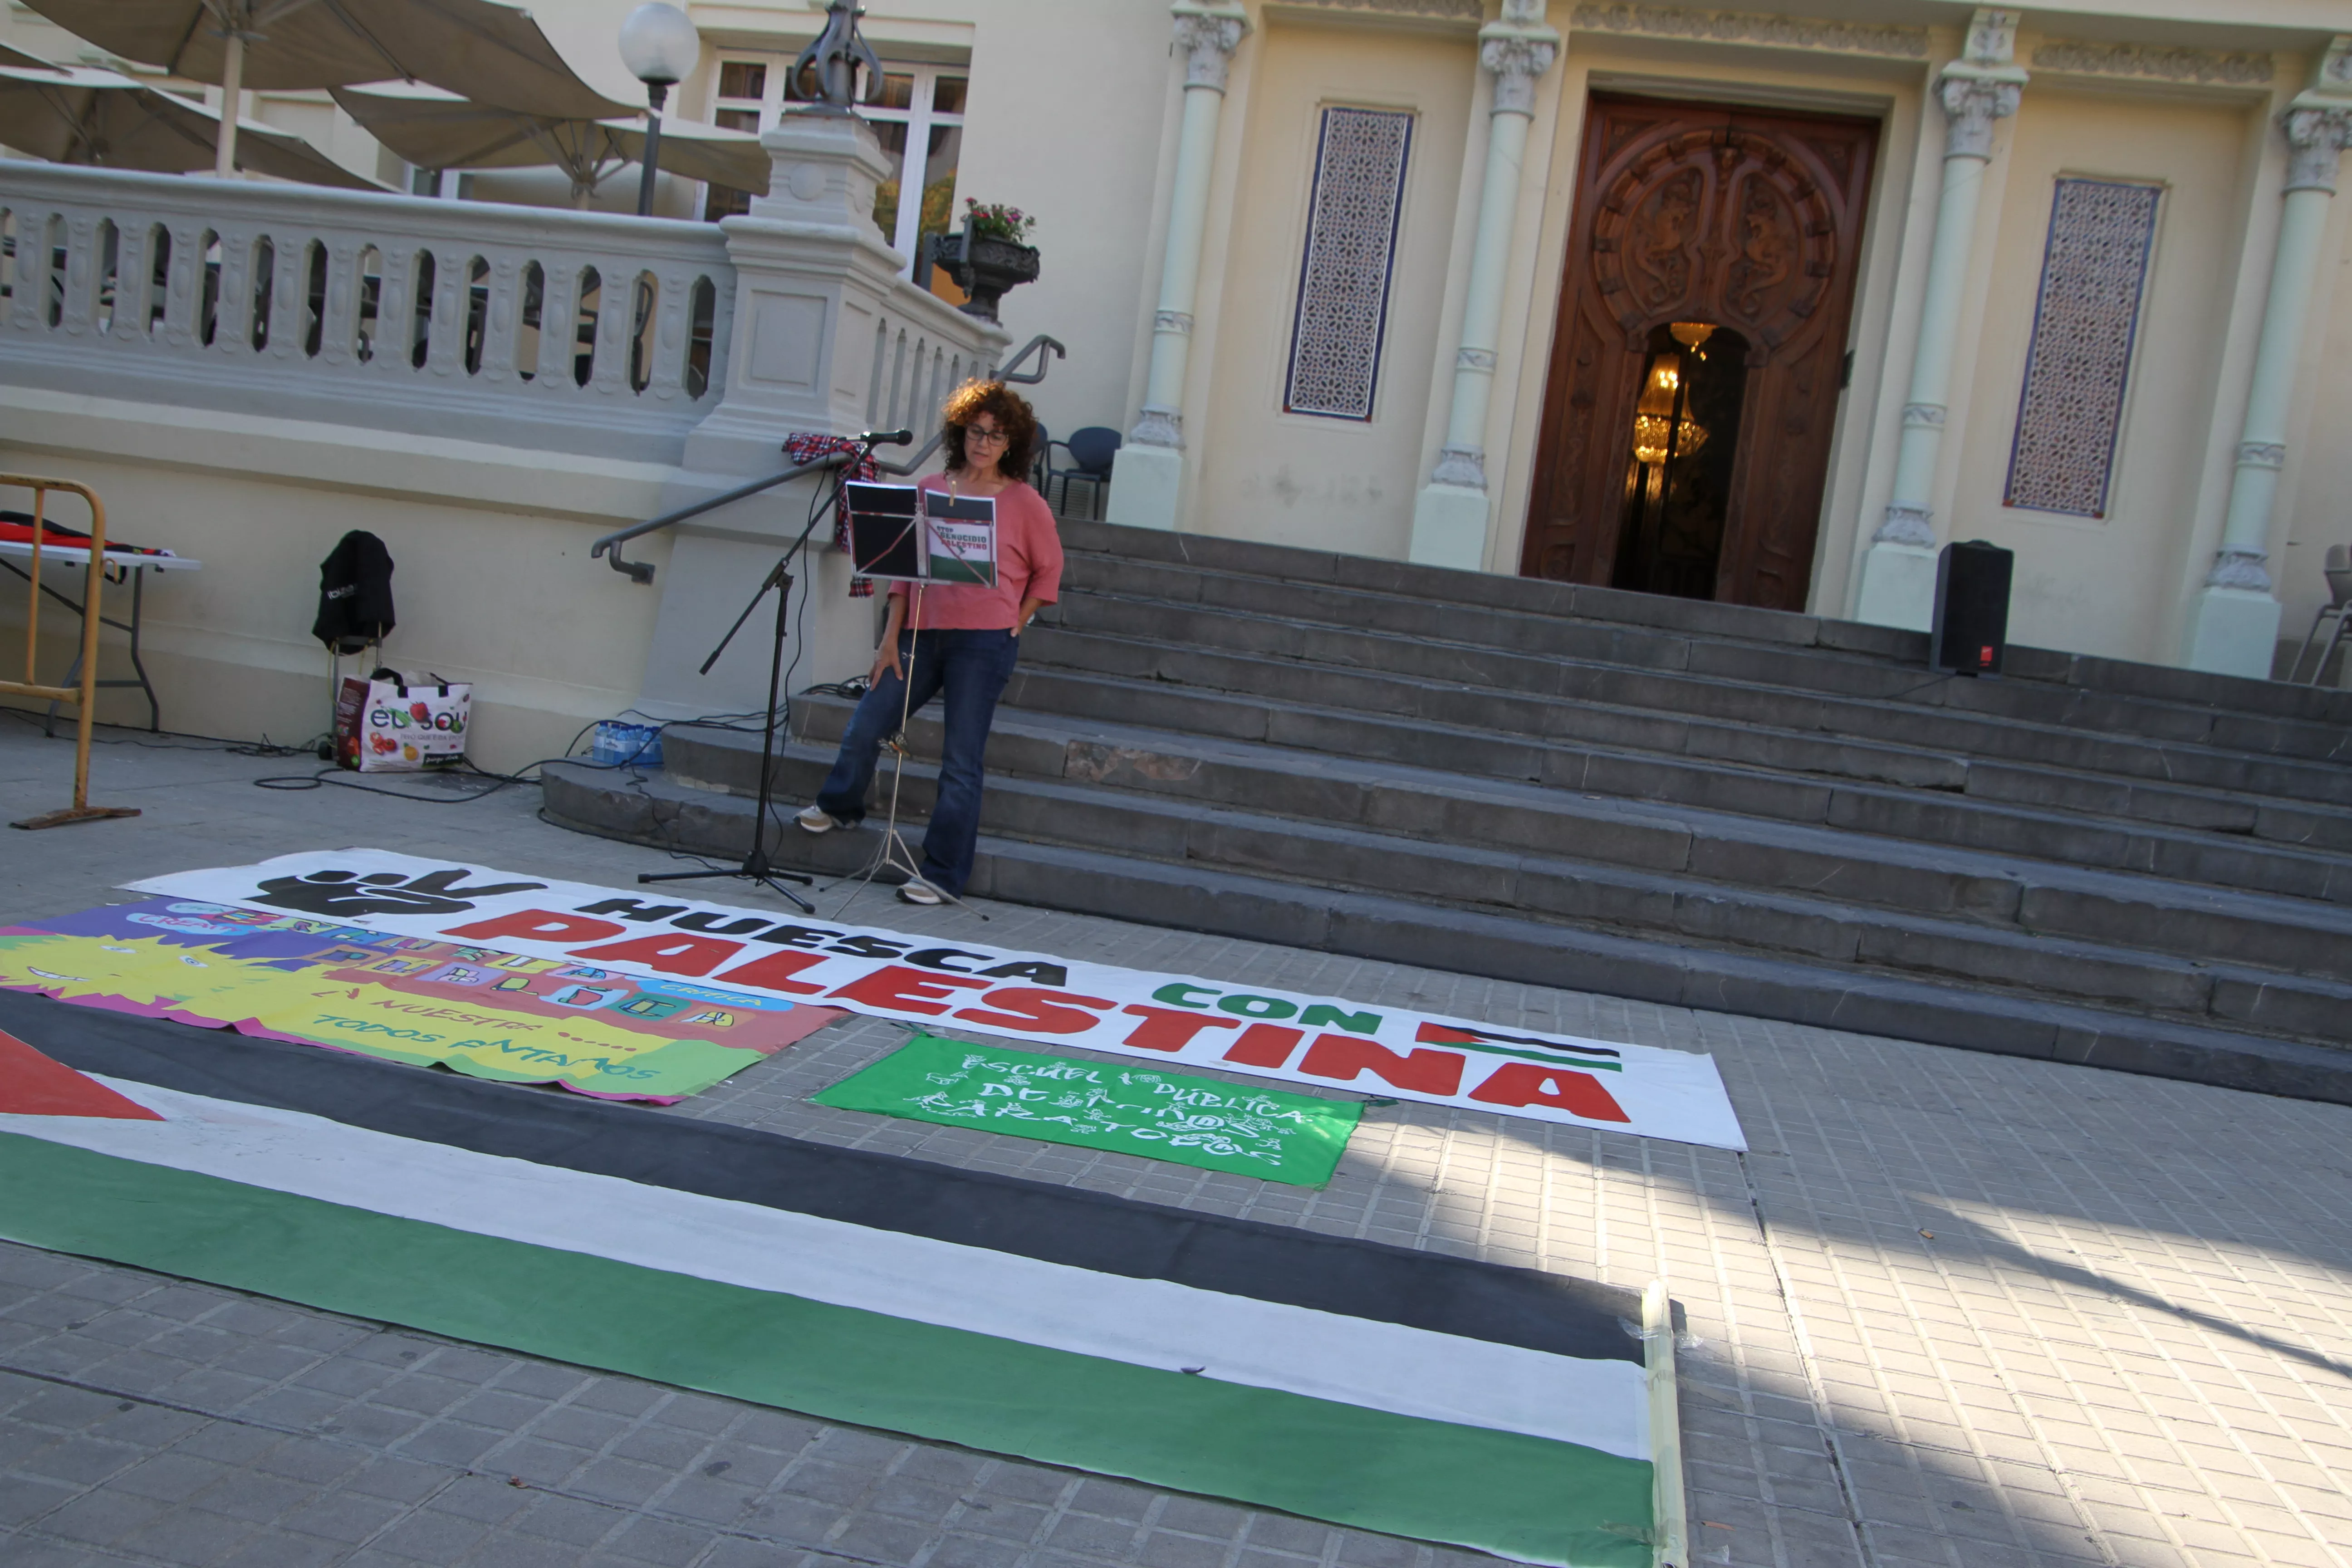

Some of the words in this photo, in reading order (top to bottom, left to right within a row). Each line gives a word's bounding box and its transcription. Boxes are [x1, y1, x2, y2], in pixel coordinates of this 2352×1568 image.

[940, 532, 987, 543] GENOCIDIO
[572, 898, 1068, 987] HUESCA
[1151, 982, 1382, 1035] CON
[313, 1014, 446, 1043] TODOS
[436, 908, 1632, 1123] PALESTINA
